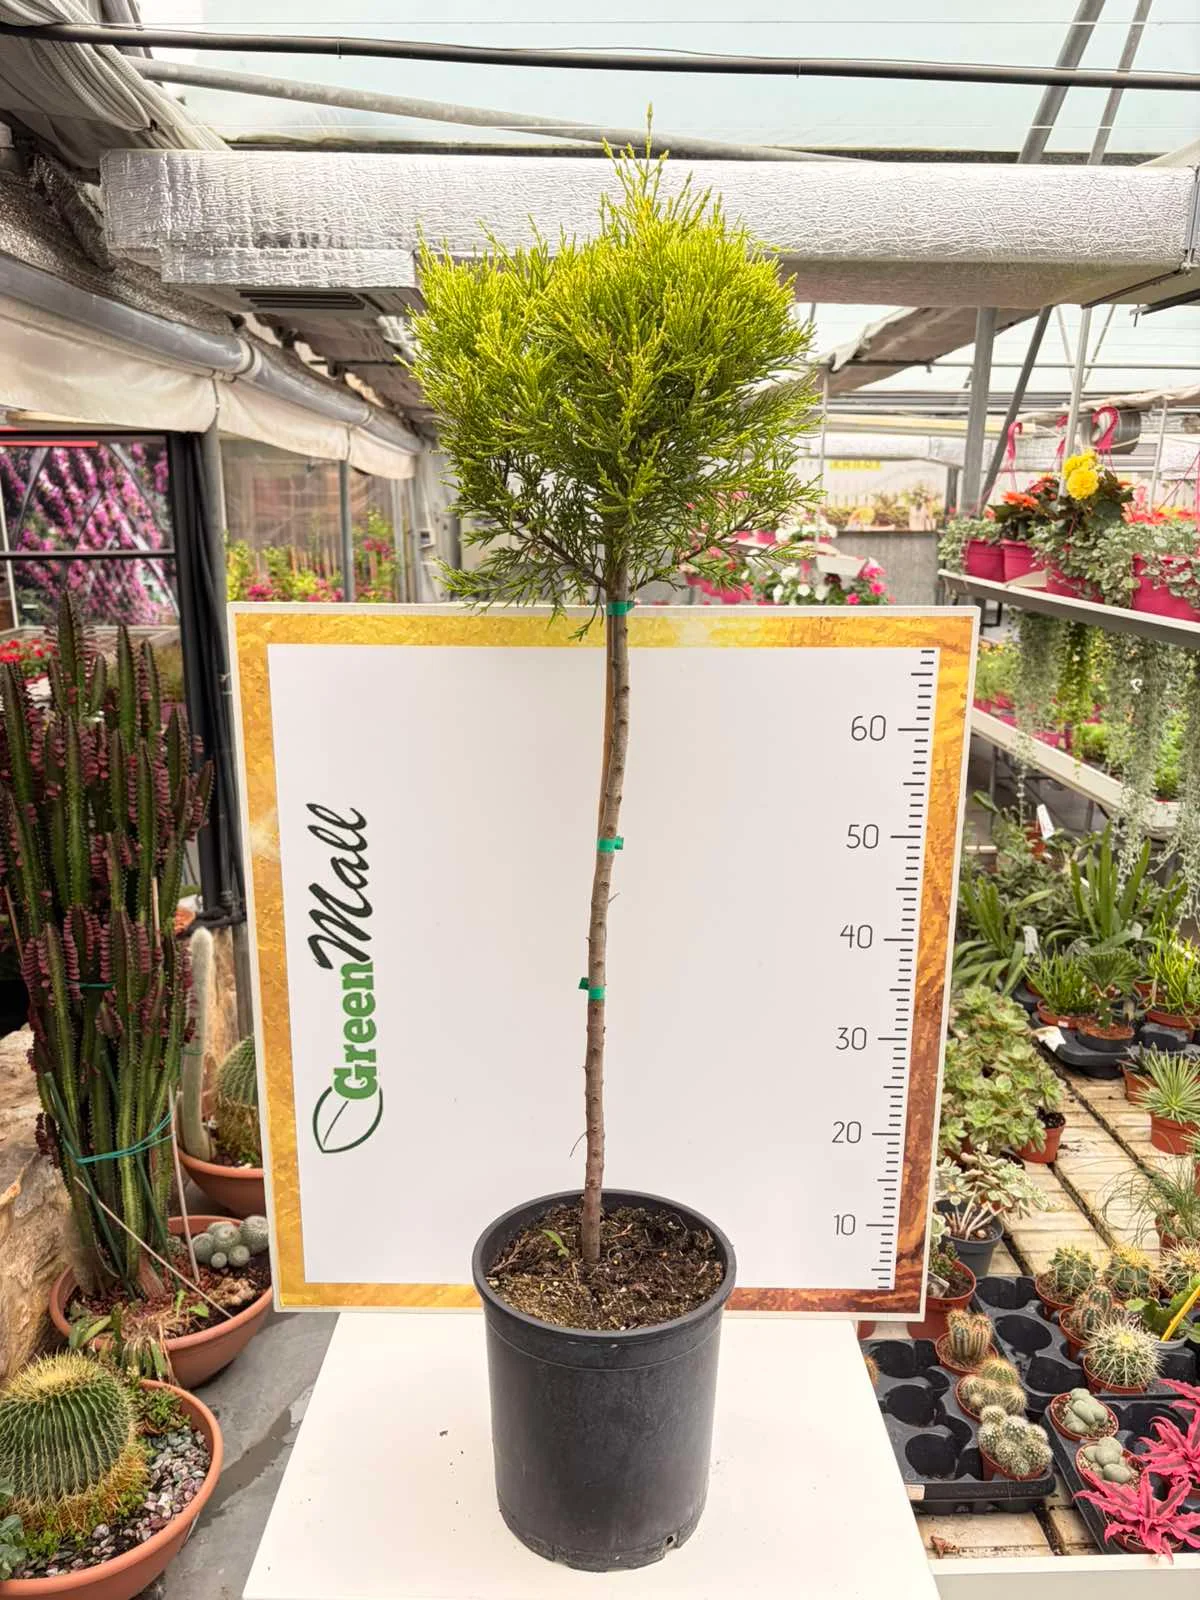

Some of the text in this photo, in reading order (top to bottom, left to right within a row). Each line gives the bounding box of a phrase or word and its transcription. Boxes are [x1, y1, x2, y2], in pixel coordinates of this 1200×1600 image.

[851, 714, 887, 742] 60
[846, 823, 879, 850] 50
[839, 924, 874, 949] 40
[835, 1027, 867, 1051] 30
[831, 1121, 862, 1144] 20
[833, 1214, 856, 1236] 10
